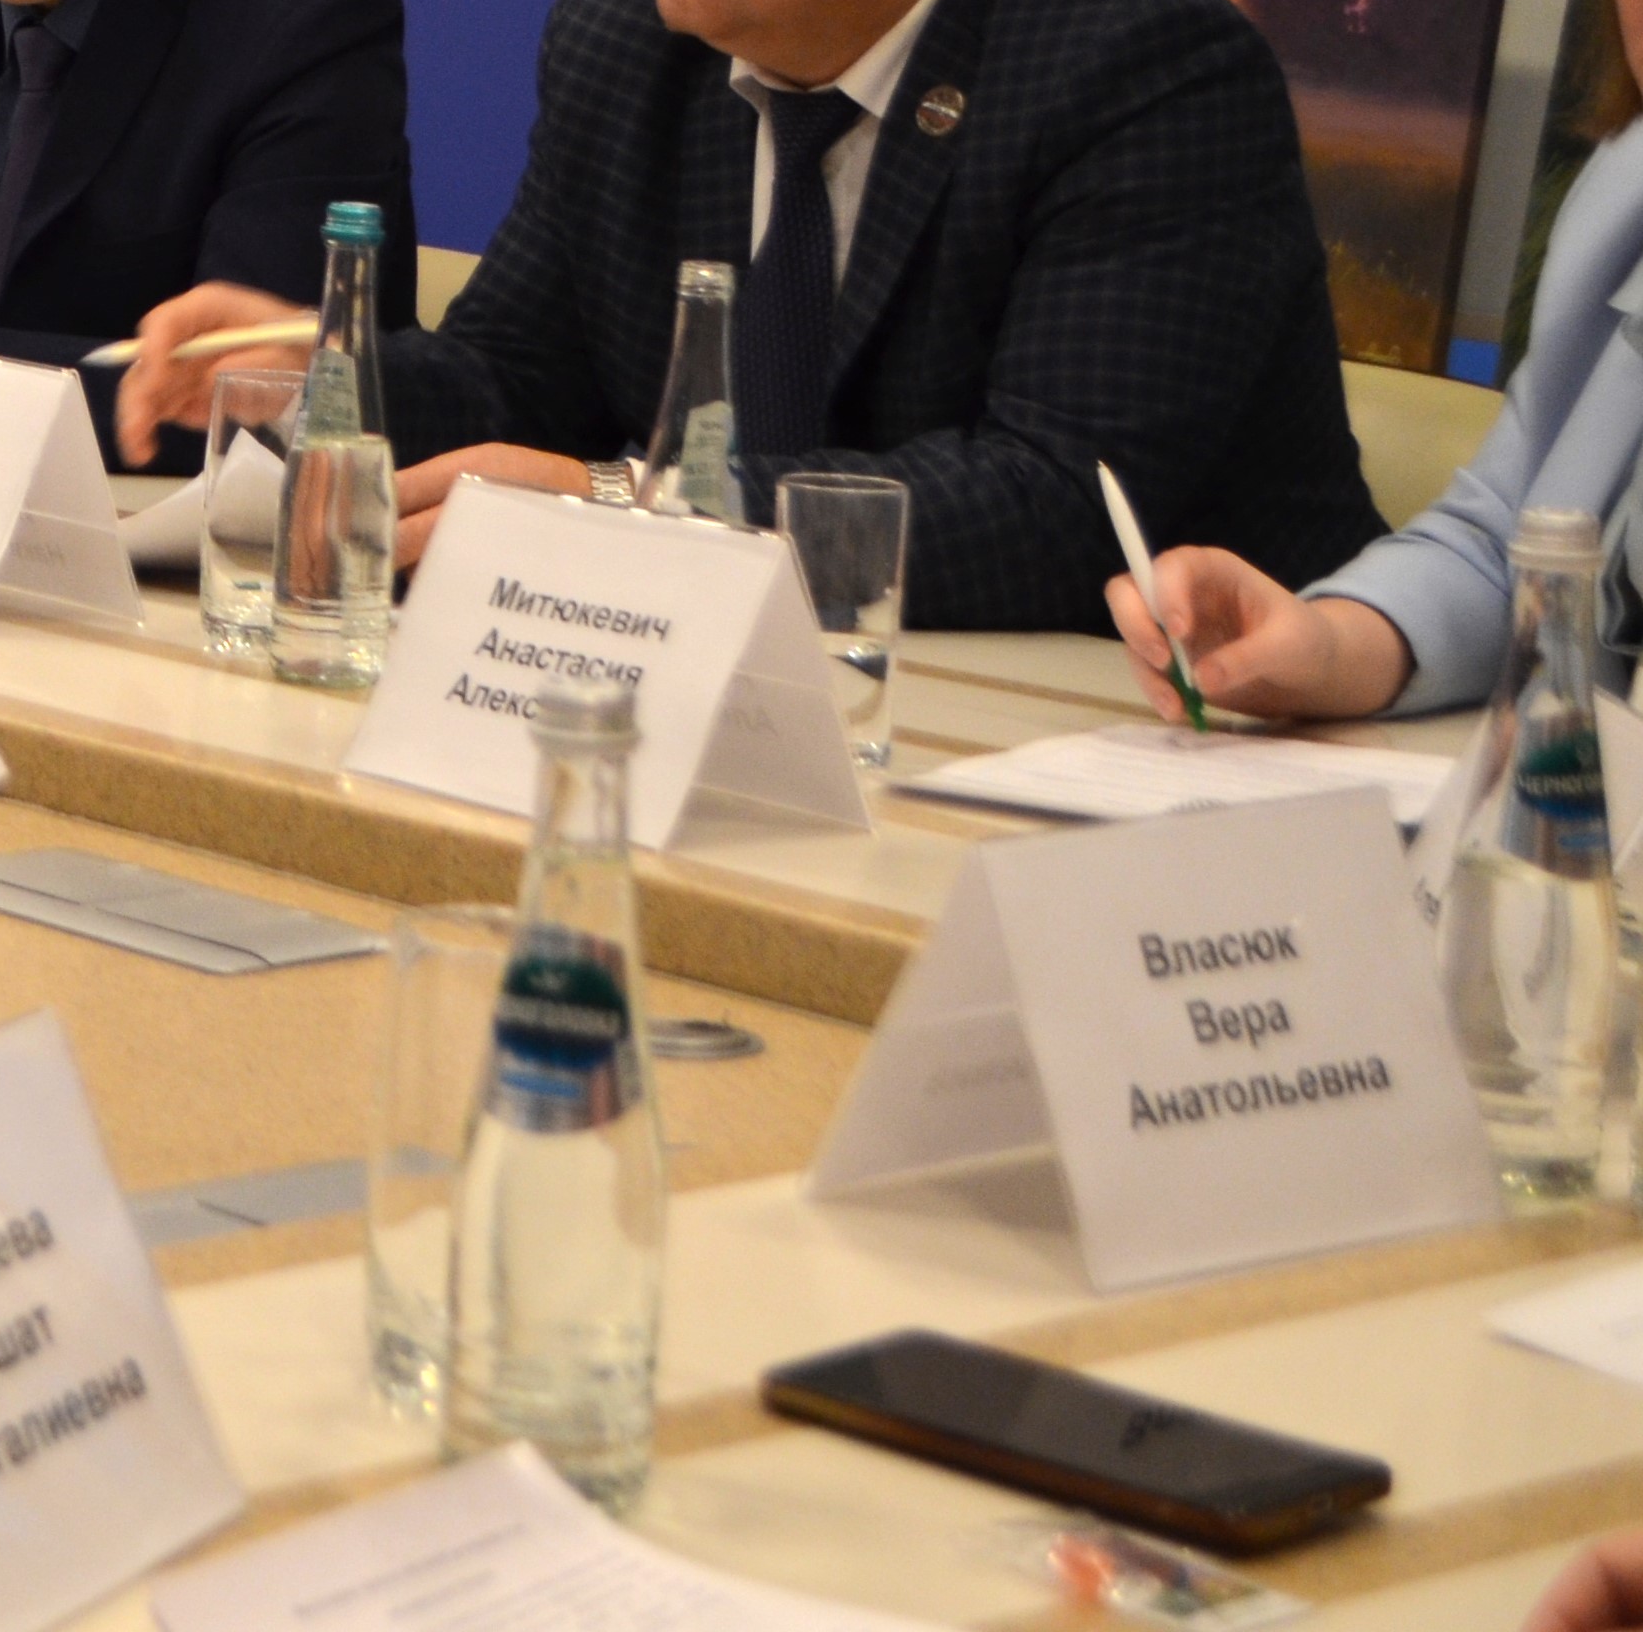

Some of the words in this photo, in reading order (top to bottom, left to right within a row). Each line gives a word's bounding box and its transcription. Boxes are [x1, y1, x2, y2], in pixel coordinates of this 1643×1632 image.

[487, 576, 672, 643] Митюкевич
[473, 627, 645, 690] Анастасия
[445, 672, 541, 722] Алекс
[1137, 917, 1302, 981] Власюк
[1183, 997, 1294, 1052] Вера
[1127, 1050, 1394, 1133] Анатольевна
